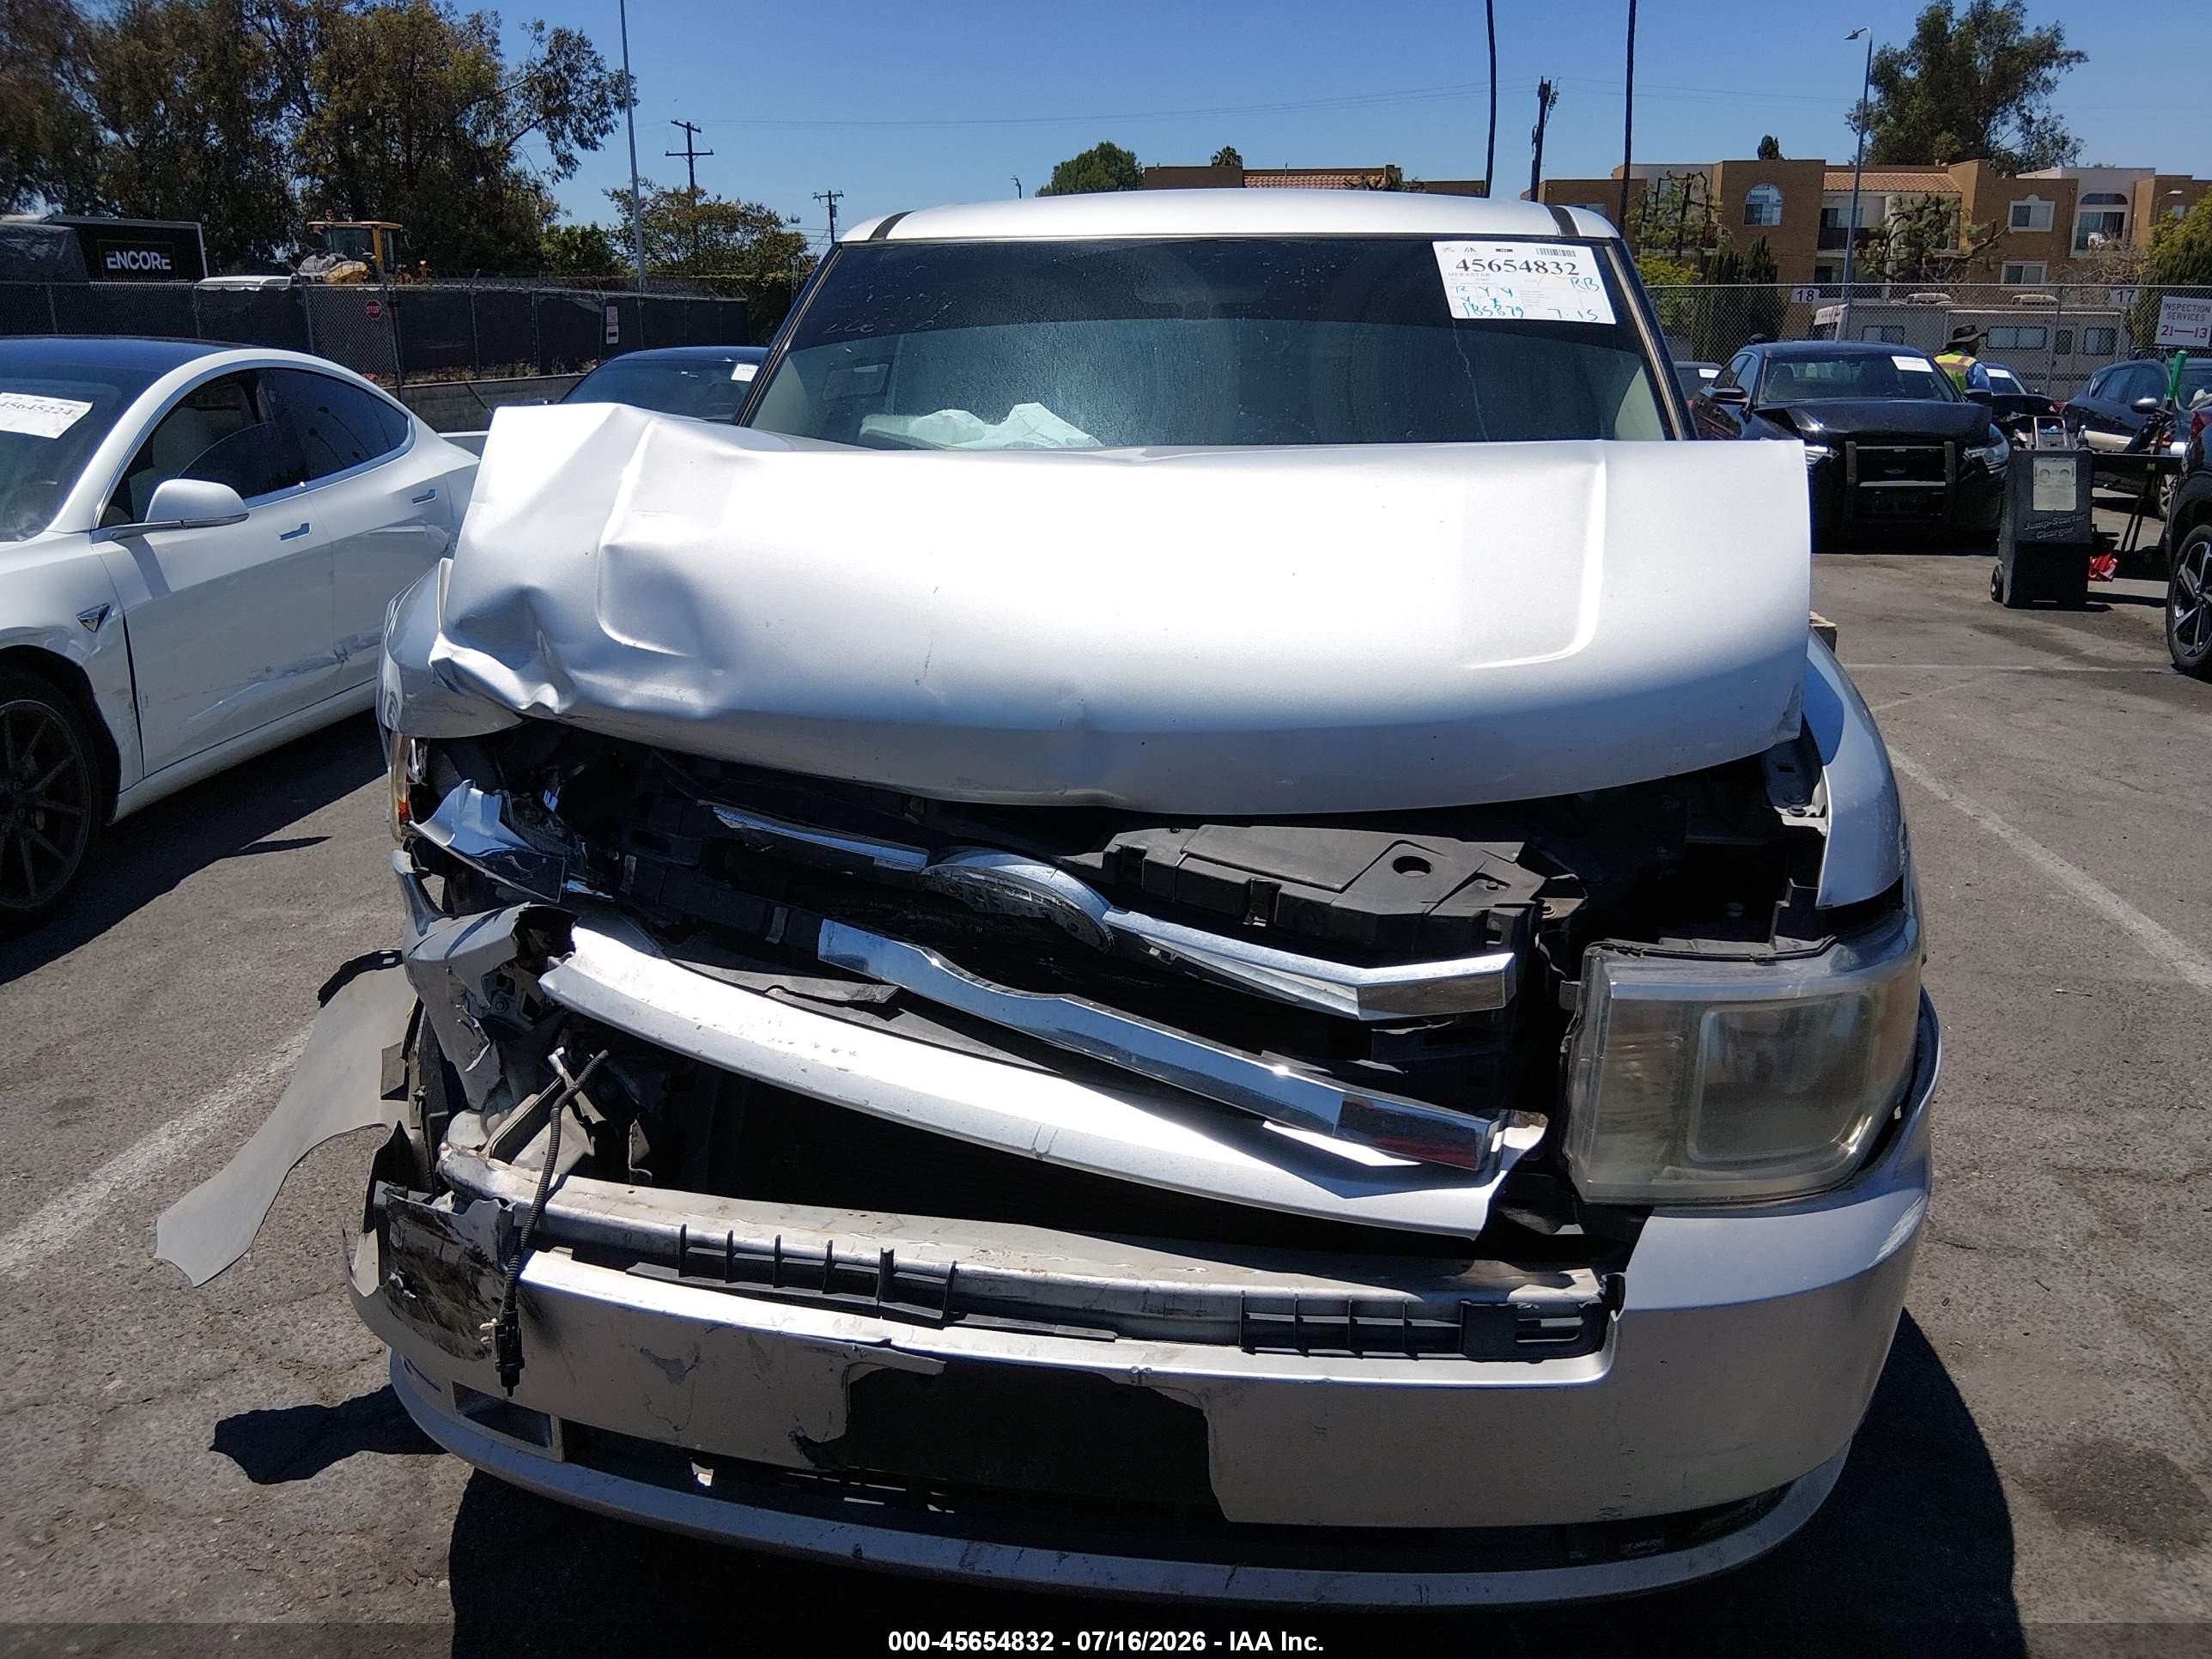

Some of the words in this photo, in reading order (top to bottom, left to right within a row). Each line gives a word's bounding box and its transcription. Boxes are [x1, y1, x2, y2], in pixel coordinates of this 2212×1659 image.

[106, 251, 172, 270] ENCORE
[1455, 258, 1579, 276] 45654832
[1797, 289, 1814, 301] 18
[2117, 290, 2136, 302] 17
[2164, 303, 2210, 313] INSPECTION
[2166, 312, 2206, 321] SERVICES
